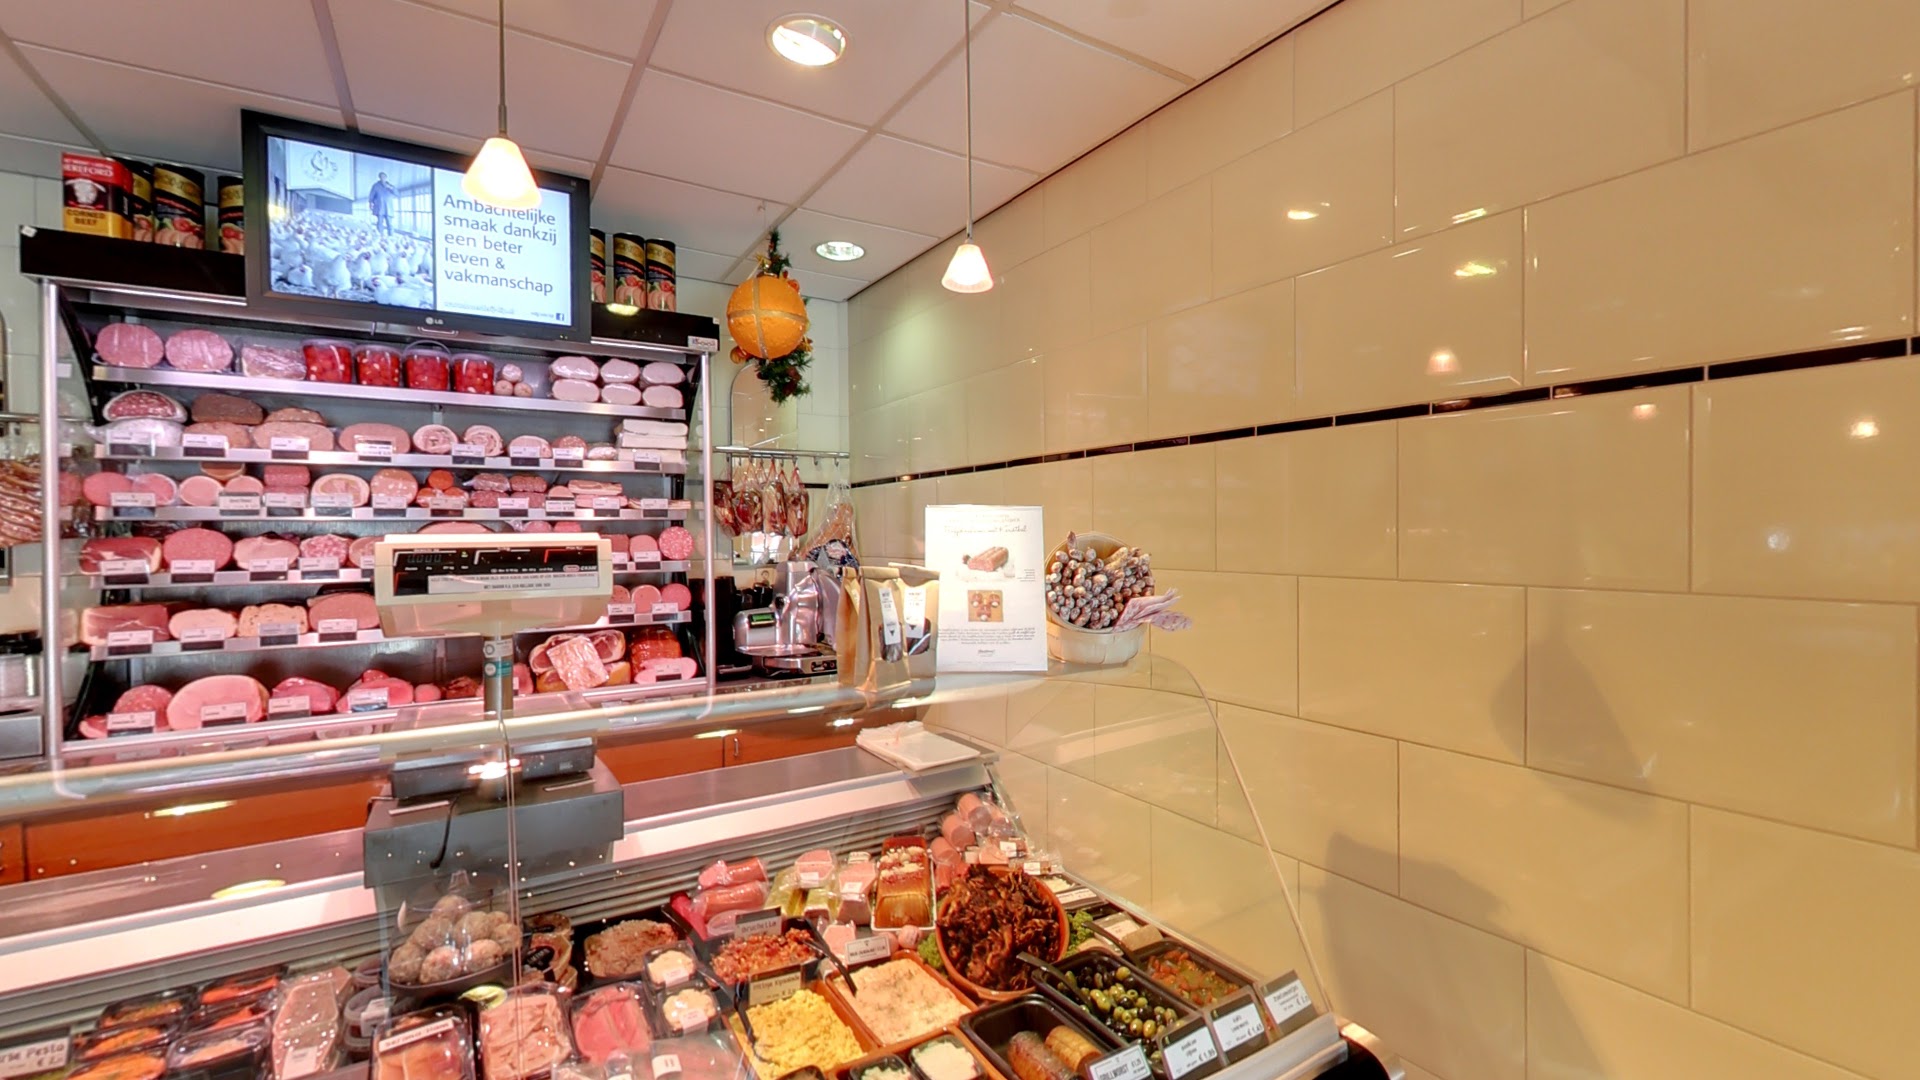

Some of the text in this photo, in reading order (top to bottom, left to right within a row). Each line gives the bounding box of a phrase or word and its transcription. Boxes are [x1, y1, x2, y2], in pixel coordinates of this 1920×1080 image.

[66, 209, 106, 219] CORNED
[74, 217, 97, 225] BEEF
[444, 215, 557, 246] smaak dankzij
[444, 233, 523, 255] een beter
[444, 247, 506, 270] leven &
[444, 268, 553, 296] vakmanschap
